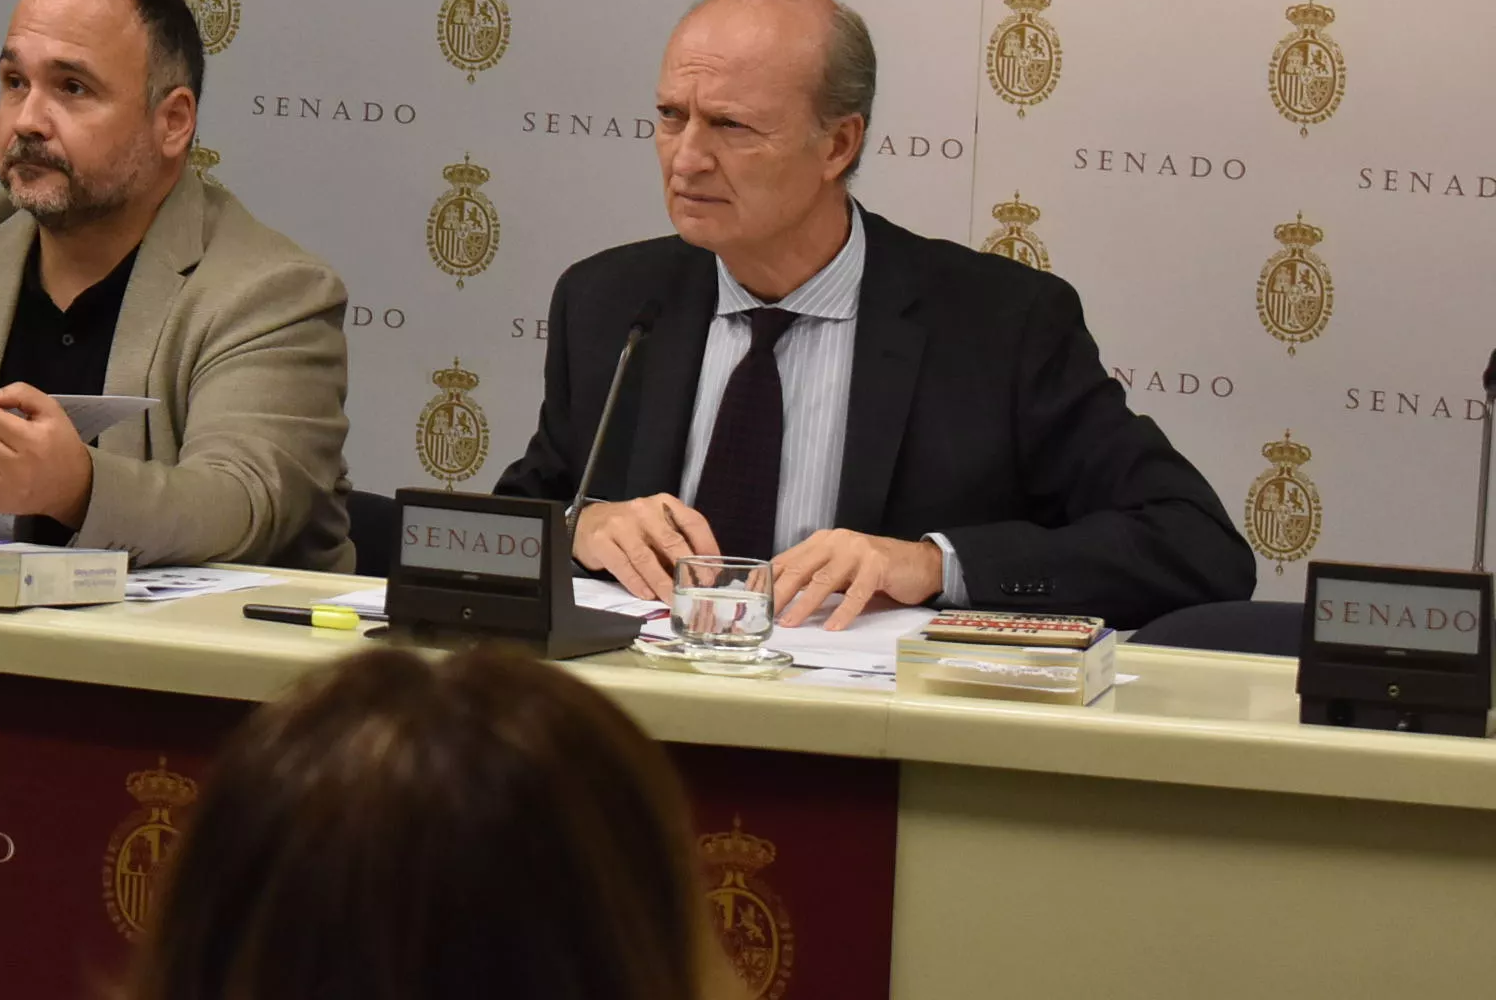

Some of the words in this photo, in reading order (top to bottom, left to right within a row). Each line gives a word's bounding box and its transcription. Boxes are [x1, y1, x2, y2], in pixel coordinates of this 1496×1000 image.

[252, 96, 416, 124] SENADO
[523, 112, 655, 139] SENAD
[1075, 149, 1246, 180] SENADO
[1359, 168, 1496, 198] SENAD
[1112, 367, 1233, 398] NADO
[1346, 388, 1489, 421] SENAD
[403, 524, 541, 558] SENADO
[1316, 598, 1477, 633] SENADO
